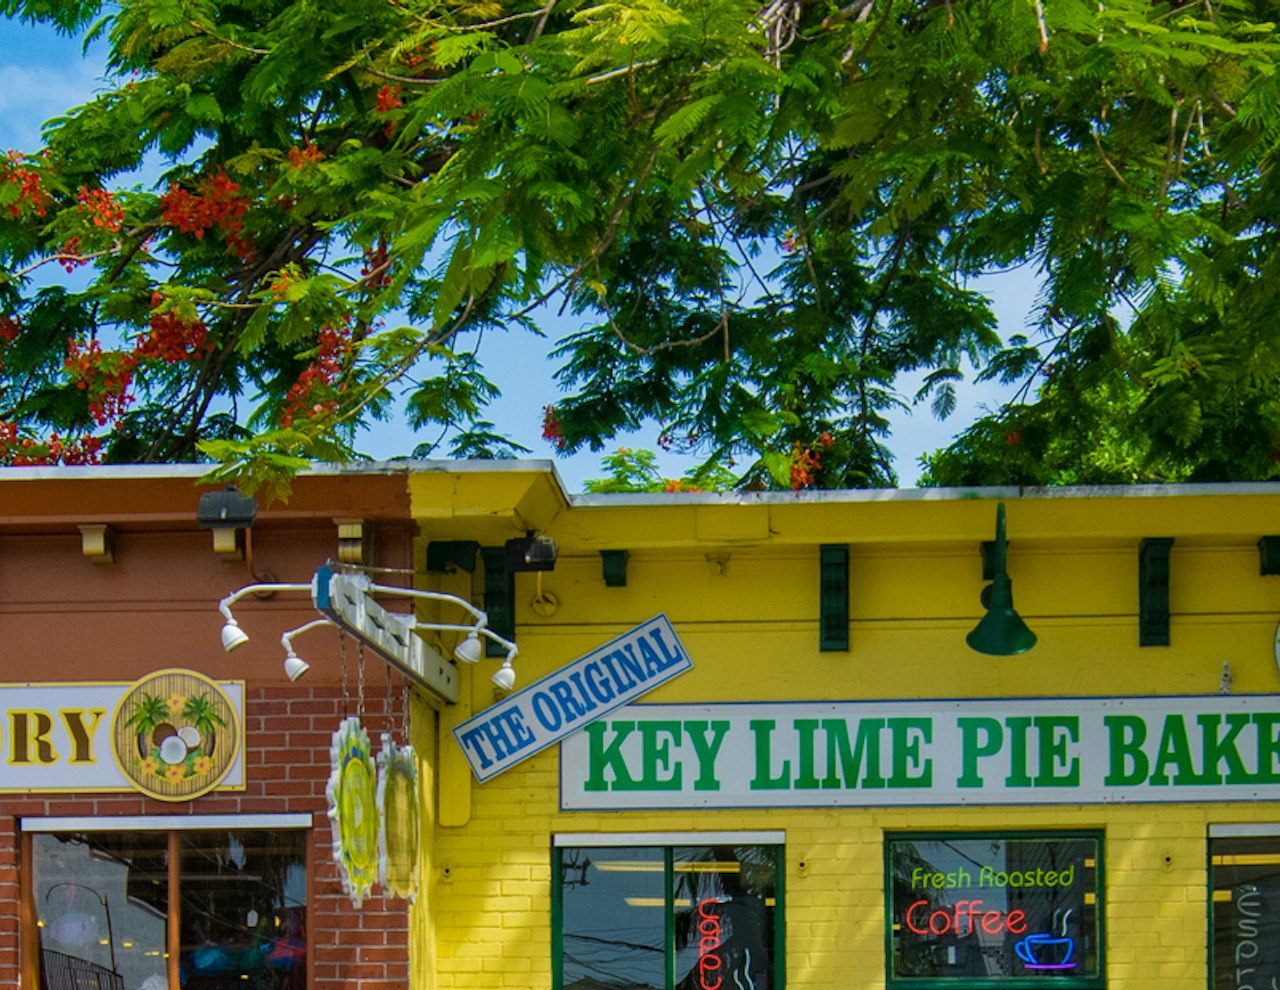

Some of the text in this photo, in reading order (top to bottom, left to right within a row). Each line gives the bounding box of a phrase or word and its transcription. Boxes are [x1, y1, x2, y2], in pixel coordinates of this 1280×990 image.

[460, 626, 684, 769] THE ORIGINAL
[583, 720, 731, 792] KEY
[749, 717, 933, 790] LIME
[956, 715, 1080, 788] PIE
[911, 864, 1075, 889] Fresh Roasted
[906, 900, 1028, 935] Coffee
